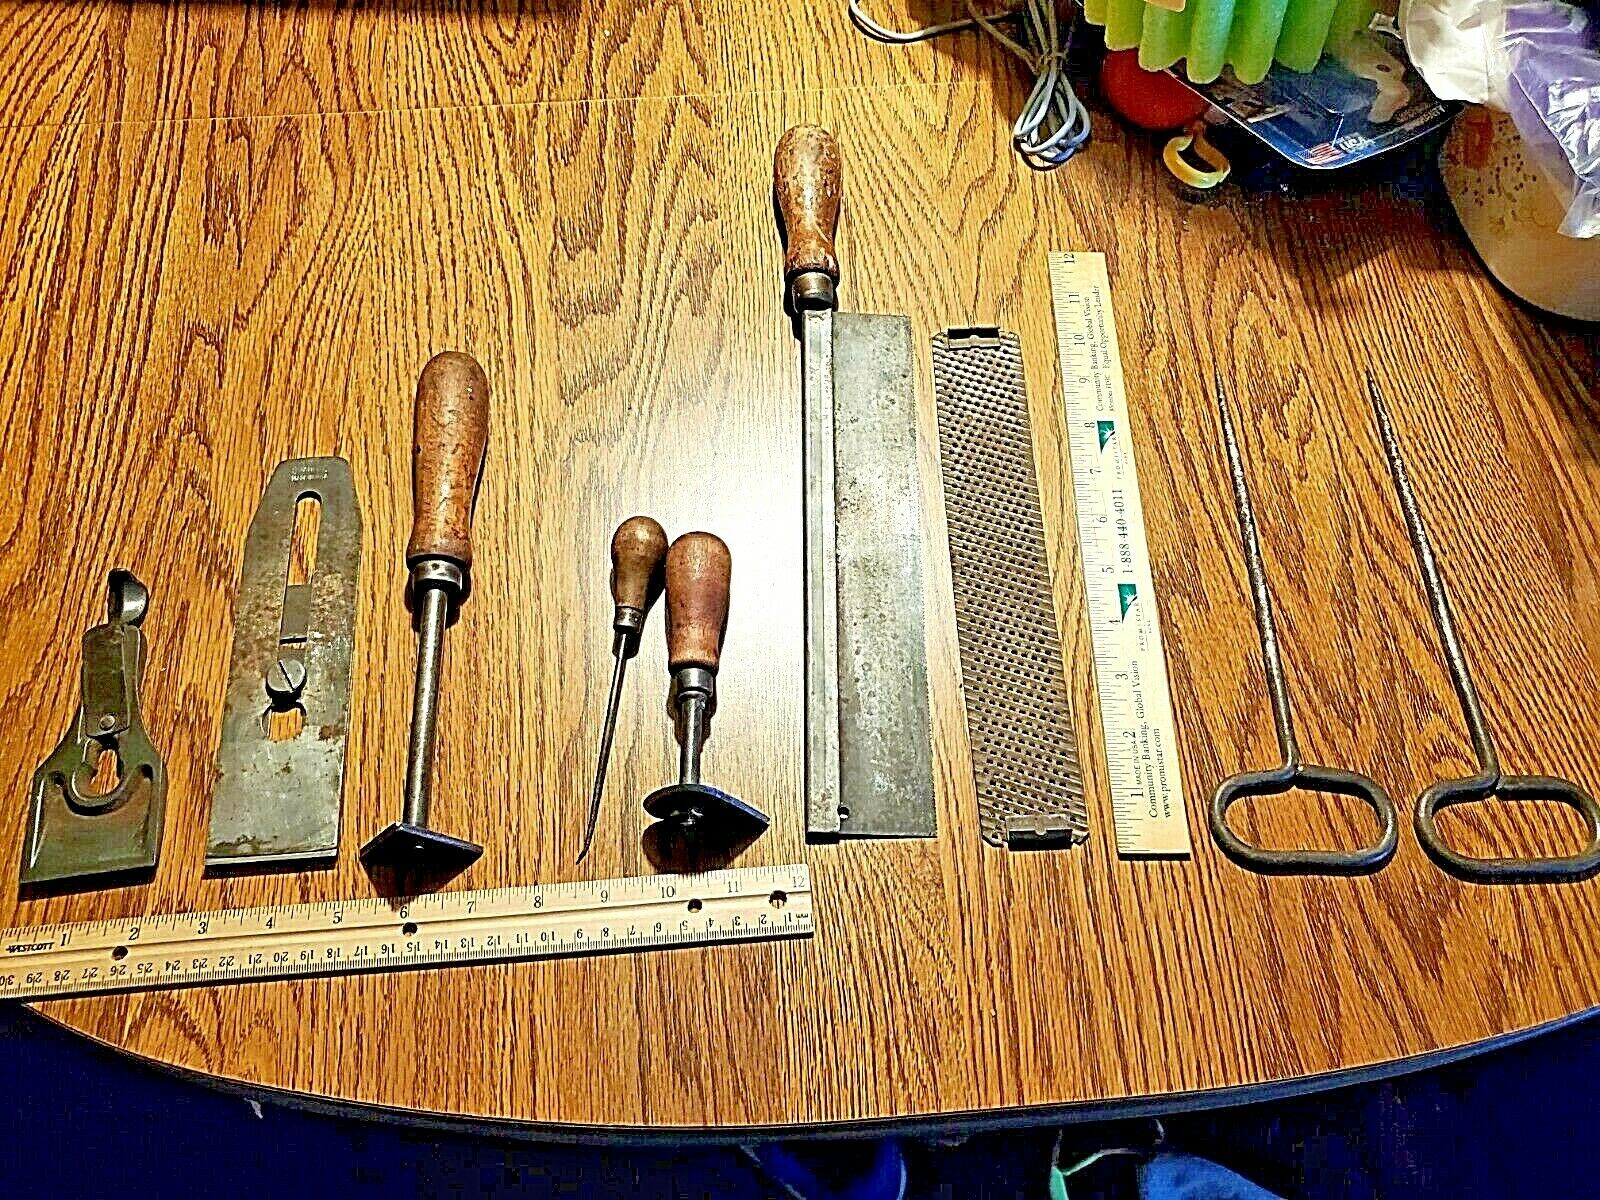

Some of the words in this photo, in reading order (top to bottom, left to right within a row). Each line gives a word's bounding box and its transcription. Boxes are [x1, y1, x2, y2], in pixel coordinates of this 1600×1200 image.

[1064, 253, 1075, 264] 12
[1069, 294, 1080, 303] 11
[1086, 318, 1095, 340] Global
[1074, 334, 1085, 346] 10
[1095, 371, 1104, 412] Community
[1096, 516, 1107, 524] 6
[1112, 490, 1133, 573] 1-888-440-4011
[1131, 660, 1141, 688] Vision
[1132, 690, 1145, 719] Global
[1140, 721, 1151, 761] Banking,
[1134, 765, 1142, 785] MADE
[1153, 728, 1171, 818] www.promistar.com
[1144, 763, 1158, 818] Community
[728, 880, 738, 893] 11
[792, 875, 805, 888] 12
[600, 889, 609, 904] 9
[661, 885, 675, 899] 10
[466, 900, 474, 914] 7
[533, 895, 542, 909] 8
[332, 911, 341, 925] 5
[400, 905, 408, 919] 6
[788, 912, 792, 923] 1
[265, 916, 273, 930] 4
[681, 919, 688, 931] 5
[708, 917, 715, 928] 4
[734, 915, 741, 927] 3
[760, 914, 767, 925] 2
[198, 921, 207, 935] 3
[576, 928, 583, 939] 9
[602, 926, 609, 938] 8
[629, 924, 636, 936] 7
[655, 921, 662, 933] 6
[60, 933, 67, 947] 1
[129, 927, 139, 941] 2
[516, 932, 529, 944] 11
[540, 930, 555, 942] 10
[6, 942, 55, 953] WESTCOTT
[406, 941, 421, 953] 15
[434, 939, 448, 950] 14
[460, 937, 474, 949] 13
[487, 935, 501, 947] 12
[300, 949, 314, 961] 19
[326, 947, 341, 959] 18
[354, 945, 368, 957] 17
[381, 943, 395, 955] 16
[192, 957, 208, 970] 23
[219, 955, 235, 968] 22
[248, 953, 263, 965] 21
[273, 951, 289, 963] 20
[109, 964, 127, 977] 26
[136, 962, 153, 975] 25
[165, 959, 181, 972] 24
[26, 971, 43, 984] 29
[54, 969, 71, 982] 28
[81, 966, 99, 980] 27
